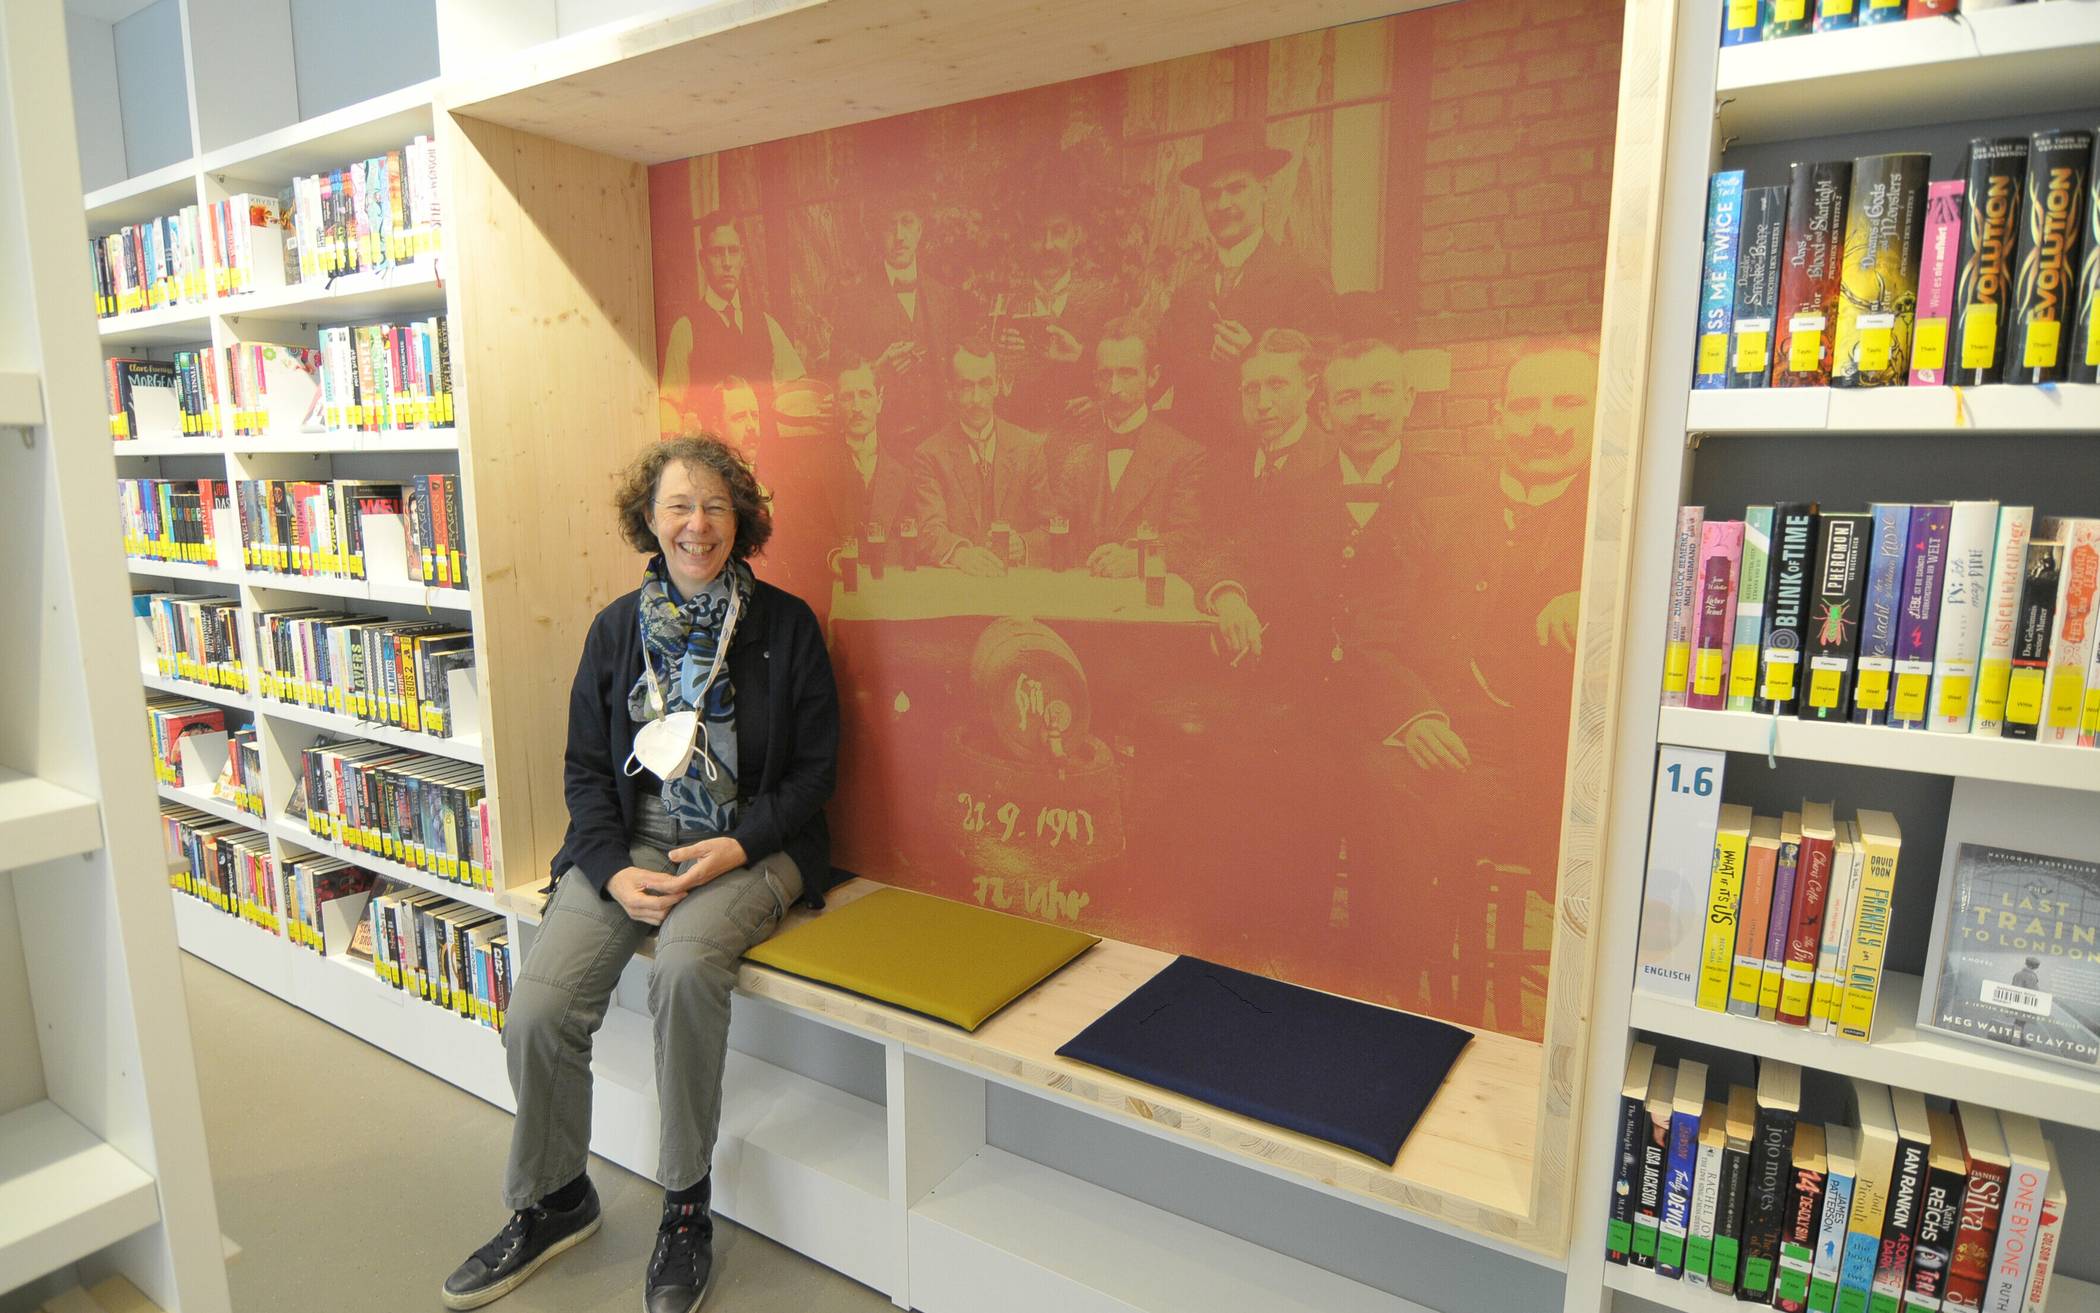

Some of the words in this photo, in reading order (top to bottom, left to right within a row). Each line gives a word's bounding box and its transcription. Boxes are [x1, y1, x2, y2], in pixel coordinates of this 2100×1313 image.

[1714, 202, 1732, 266] TWICE
[1978, 175, 2009, 304] VOLUTION
[1710, 271, 1728, 299] ME
[1707, 308, 1724, 334] ISS
[431, 494, 441, 544] RAGON
[1677, 532, 1689, 569] BEMERKT
[1782, 515, 1809, 561] TIME
[1927, 536, 1941, 564] WELT
[1687, 543, 1697, 581] NIEMAND
[1787, 560, 1800, 573] OF
[1827, 526, 1849, 589] PHEROMON
[1674, 571, 1686, 597] GLÜCK
[1684, 585, 1694, 606] MICH
[1674, 598, 1683, 617] ZUM
[1776, 572, 1803, 627] BLINK
[1908, 595, 1922, 620] LIEBE
[2024, 605, 2037, 642] Geheimnis
[2036, 607, 2047, 632] Mutter
[2022, 643, 2032, 657] Das
[387, 660, 396, 695] ALAMUS
[405, 674, 415, 698] EBOS
[1981, 719, 1997, 728] dtv
[1667, 764, 1713, 796] 1.6
[1719, 850, 1736, 878] WHAT
[1870, 854, 1894, 869] DAVID
[1870, 864, 1891, 878] YOON
[1711, 904, 1733, 926] US
[1856, 887, 1890, 948] FRANKLY
[2002, 892, 2070, 915] LAST
[1974, 906, 2096, 945] TRAIN
[1862, 950, 1873, 961] in
[1962, 927, 1989, 941] TO
[1999, 934, 2100, 963] LONDON
[1645, 965, 1691, 982] ENGLISCH
[1849, 965, 1876, 992] LOV
[1943, 1015, 1972, 1027] MEG
[1977, 1021, 2022, 1039] WAITE
[2025, 1033, 2097, 1055] CLAYTON
[1624, 1119, 1634, 1150] Midnight
[1763, 1125, 1787, 1158] jojo
[1646, 1146, 1662, 1165] LISA
[1903, 1147, 1921, 1174] IAN
[1641, 1165, 1660, 1207] JACKSON
[1759, 1161, 1778, 1211] moyes
[1970, 1168, 2000, 1182] DANIEL
[1704, 1172, 1717, 1216] RACHEL
[1824, 1179, 1839, 1233] PATTERSON
[1854, 1178, 1873, 1223] Picoult
[1871, 1193, 1884, 1216] Jodi
[1893, 1175, 1916, 1229] RANKIN
[1961, 1177, 2001, 1231] Silva
[2015, 1172, 2038, 1213] ONE
[1666, 1192, 1685, 1228] DEVIO
[1798, 1196, 1813, 1227] DEADLY
[1835, 1193, 1847, 1224] JAMES
[1922, 1186, 1945, 1242] REICHS
[1940, 1204, 1957, 1232] Kathy
[1701, 1220, 1713, 1238] JOY
[1794, 1226, 1810, 1242] SIN
[2010, 1215, 2029, 1238] BY
[1882, 1239, 1896, 1268] DARK
[2002, 1239, 2024, 1278] ONE
[2041, 1232, 2054, 1261] COLSON
[1997, 1282, 2012, 1312] RUTH
[2031, 1262, 2047, 1303] WHITEHEAD
